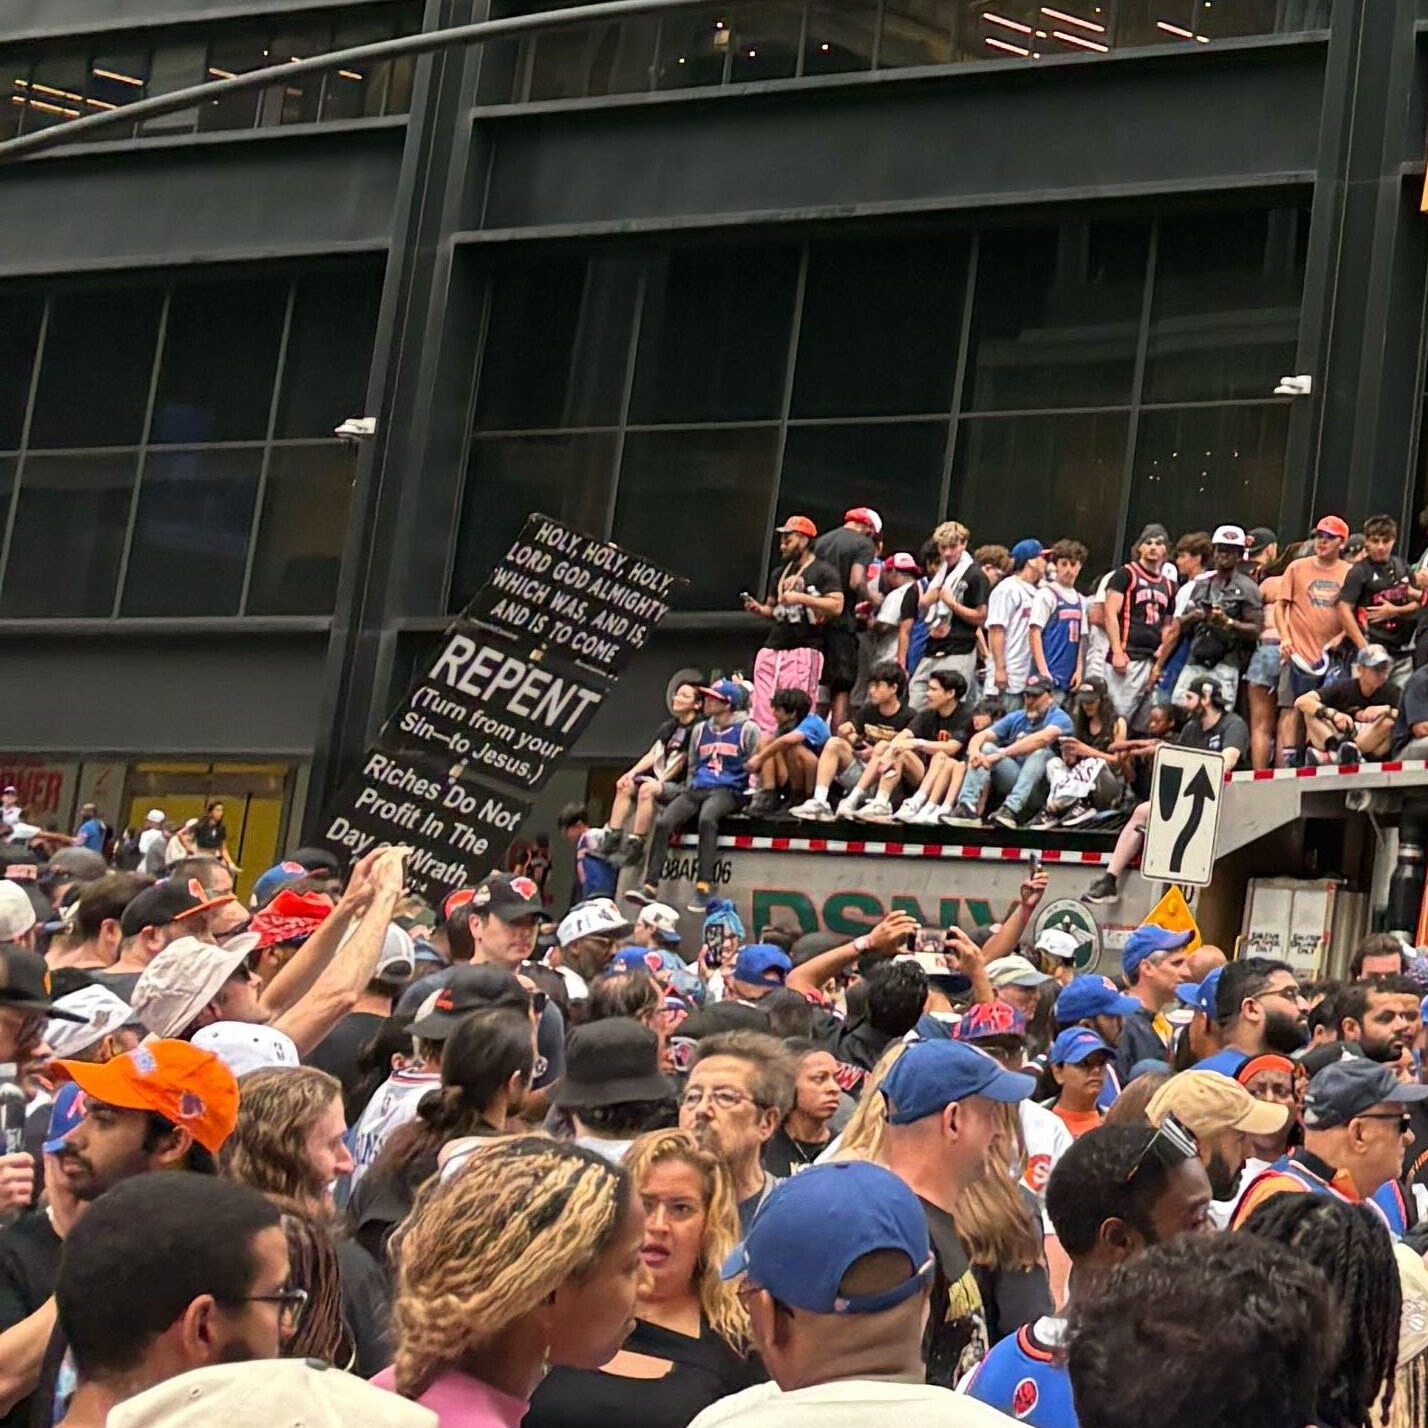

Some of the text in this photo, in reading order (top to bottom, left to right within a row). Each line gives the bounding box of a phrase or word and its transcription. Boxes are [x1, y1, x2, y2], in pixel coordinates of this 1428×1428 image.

[506, 541, 669, 622] LORD GOD ALMIGHTY
[534, 522, 674, 597] HOLY, HOLY, HOLY,
[490, 599, 620, 663] AND IS TO COME
[493, 567, 647, 649] WHICH WAS, AND IS,
[428, 634, 602, 733] REPENT
[411, 686, 563, 759] (Turn from your
[363, 753, 521, 832] Riches Do Not
[472, 743, 544, 785] Jesus.)
[326, 817, 375, 855] Day
[354, 787, 489, 856] Profit In The
